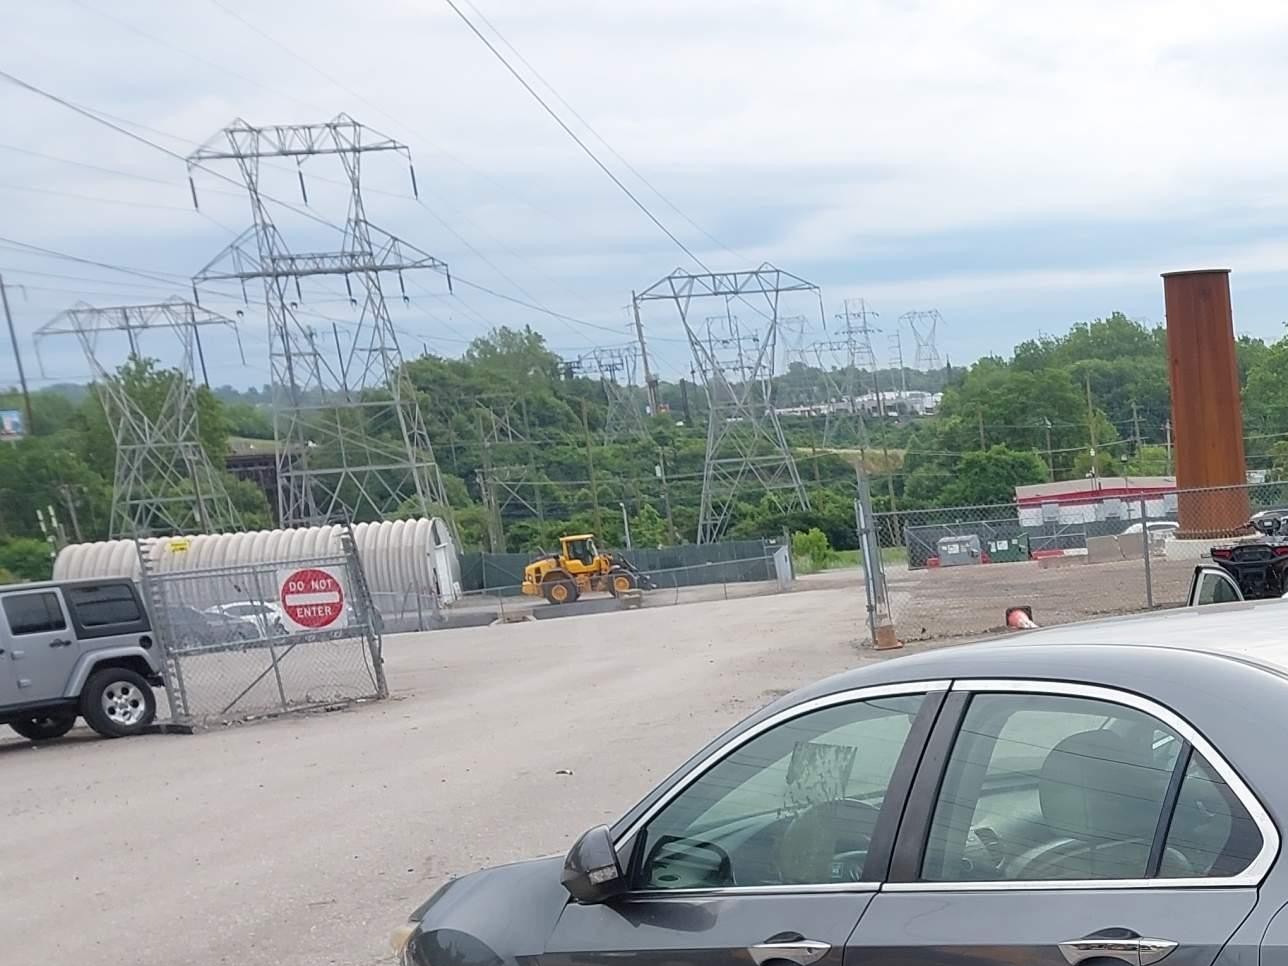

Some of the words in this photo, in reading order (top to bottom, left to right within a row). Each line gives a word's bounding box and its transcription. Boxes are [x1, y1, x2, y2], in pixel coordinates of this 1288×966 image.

[289, 581, 304, 592] DO
[311, 579, 332, 590] NOT
[296, 606, 332, 618] ENTER
